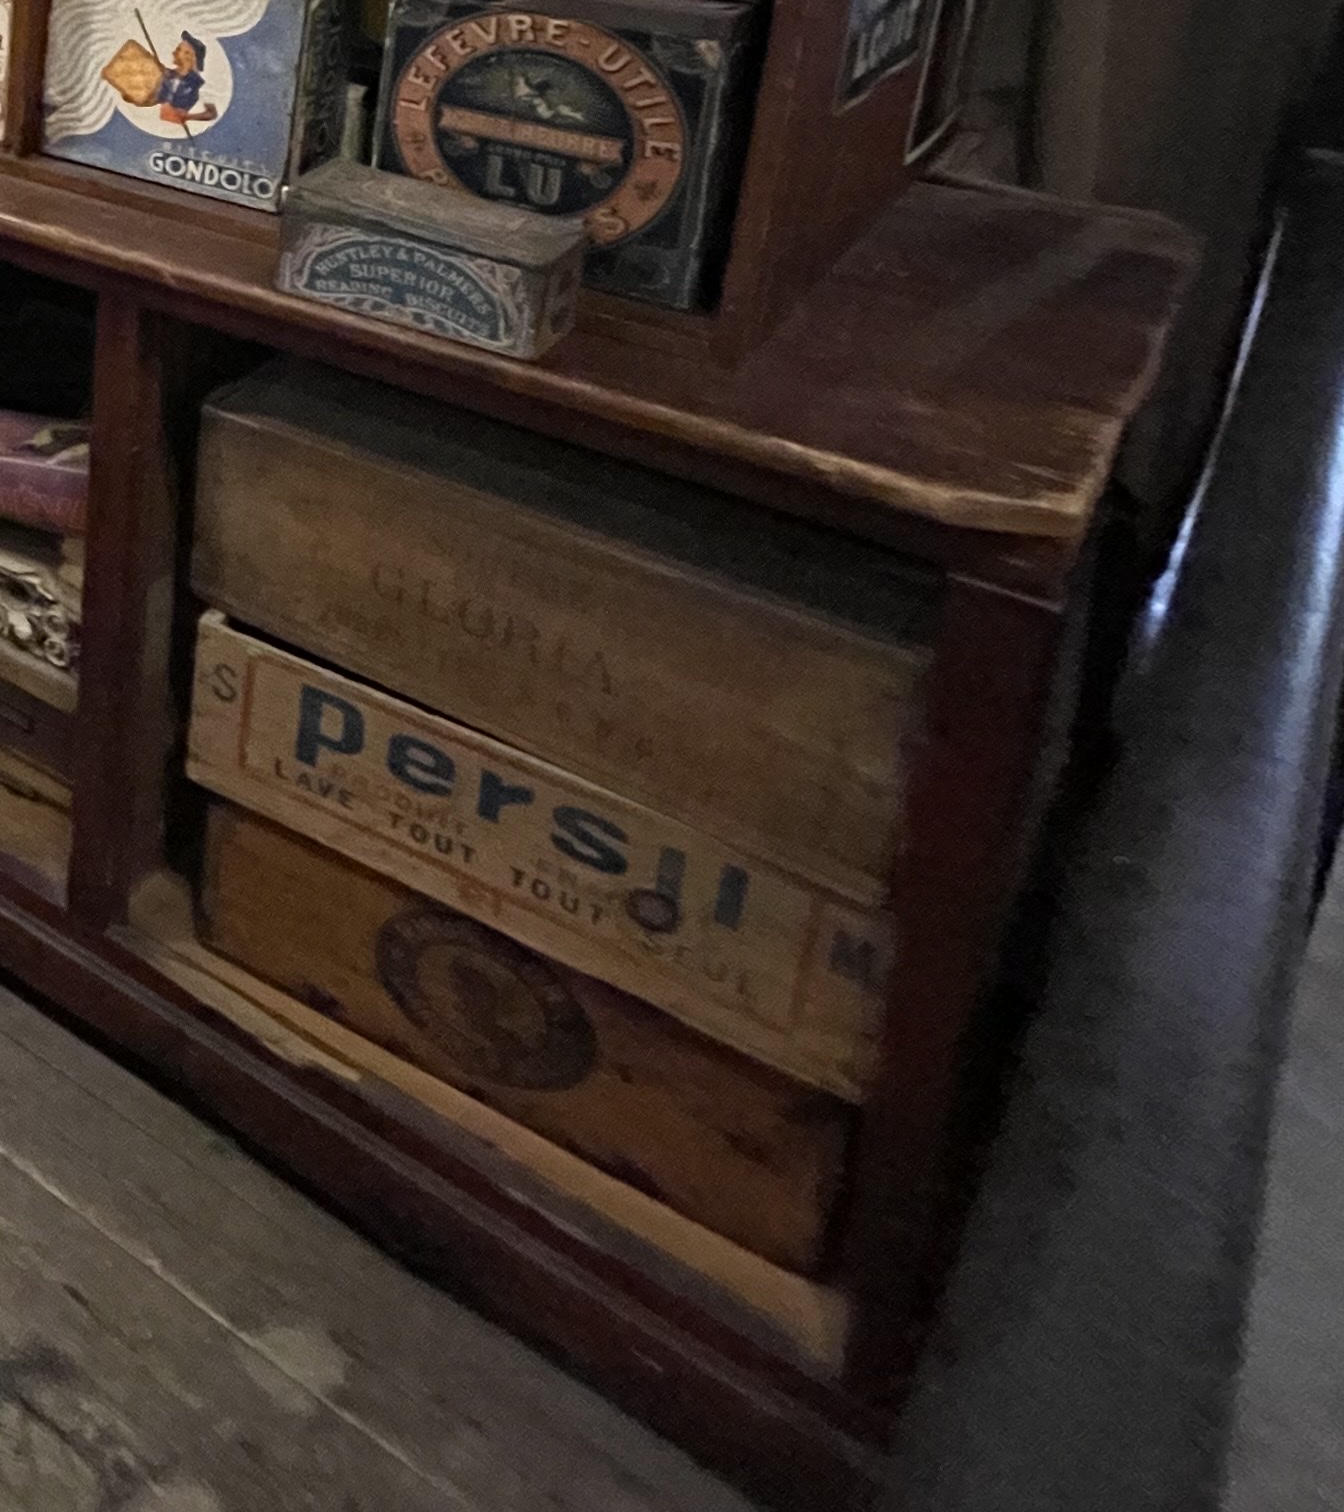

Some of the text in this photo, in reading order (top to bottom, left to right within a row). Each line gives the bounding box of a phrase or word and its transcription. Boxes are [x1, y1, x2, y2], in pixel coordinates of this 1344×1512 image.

[398, 13, 681, 162] LEFEVRE-UTILE
[149, 151, 282, 201] GONDOLO
[484, 154, 563, 207] LU
[315, 245, 493, 315] HUNTLEY & PALMERS
[349, 263, 455, 303] SUPERIOR
[272, 757, 356, 812] LAVE
[388, 813, 478, 866] TOUT
[510, 864, 604, 924] TOUT
